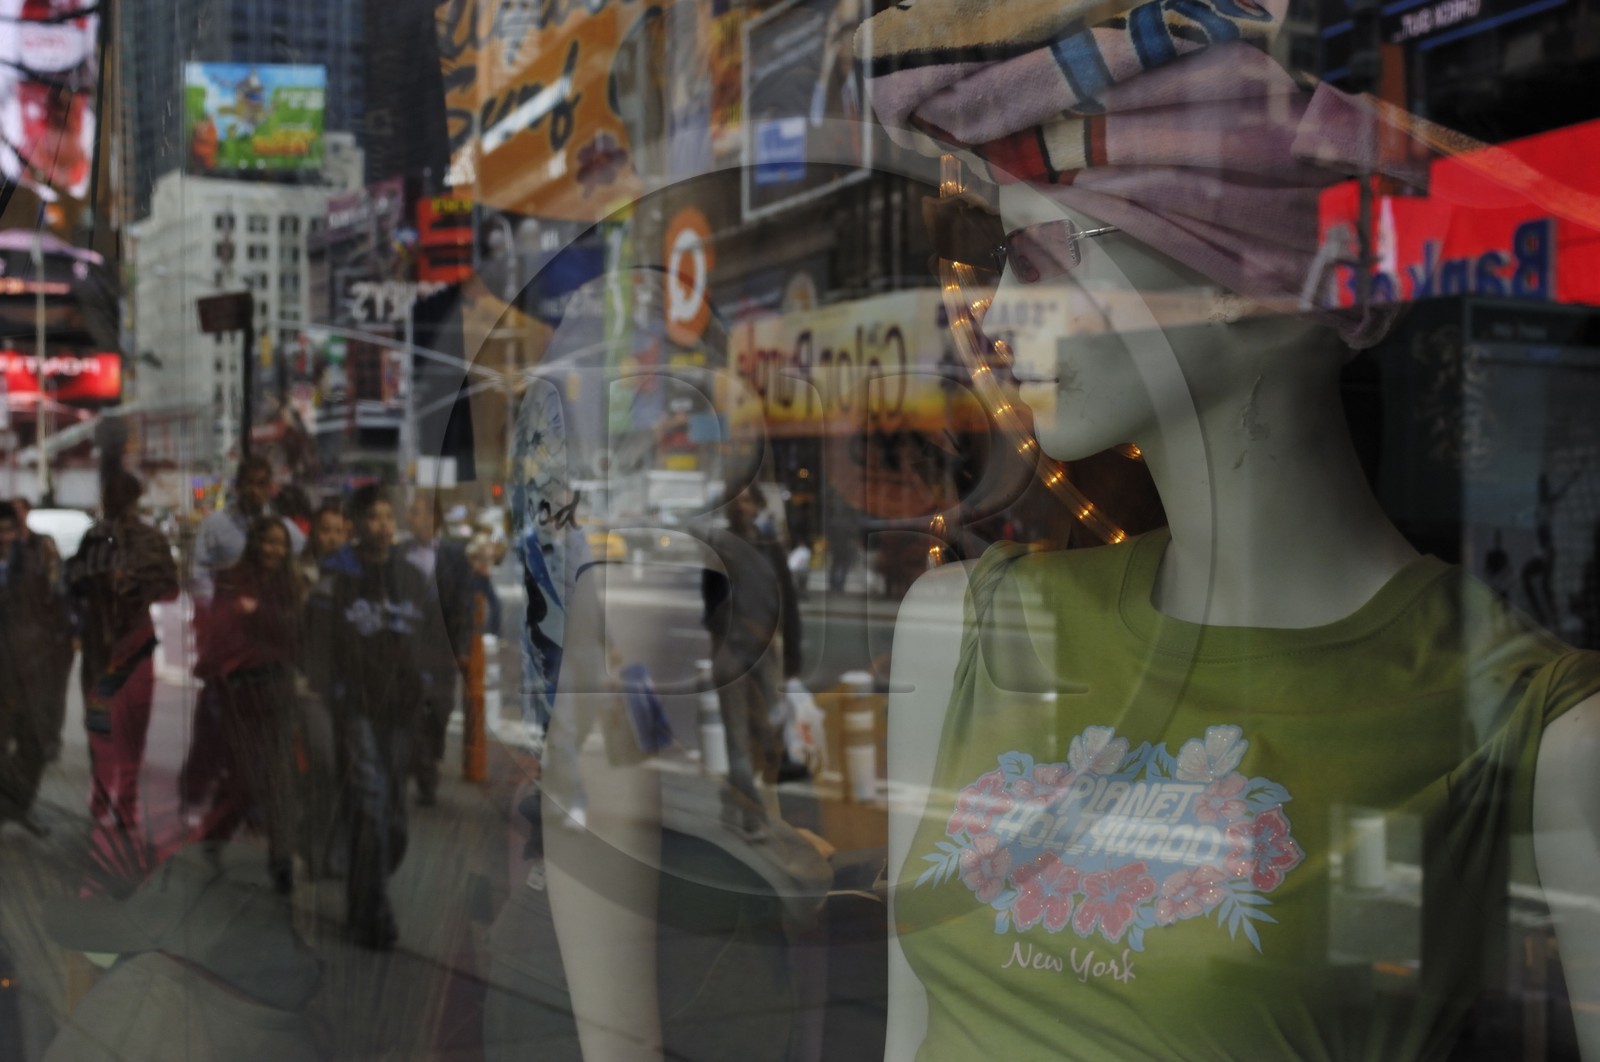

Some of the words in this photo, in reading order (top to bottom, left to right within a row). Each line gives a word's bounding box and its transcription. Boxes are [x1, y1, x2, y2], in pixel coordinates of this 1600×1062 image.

[1057, 774, 1207, 826] PLANET
[994, 802, 1224, 865] HOLLYWOOD
[1000, 941, 1065, 973] New
[1070, 946, 1138, 984] York
